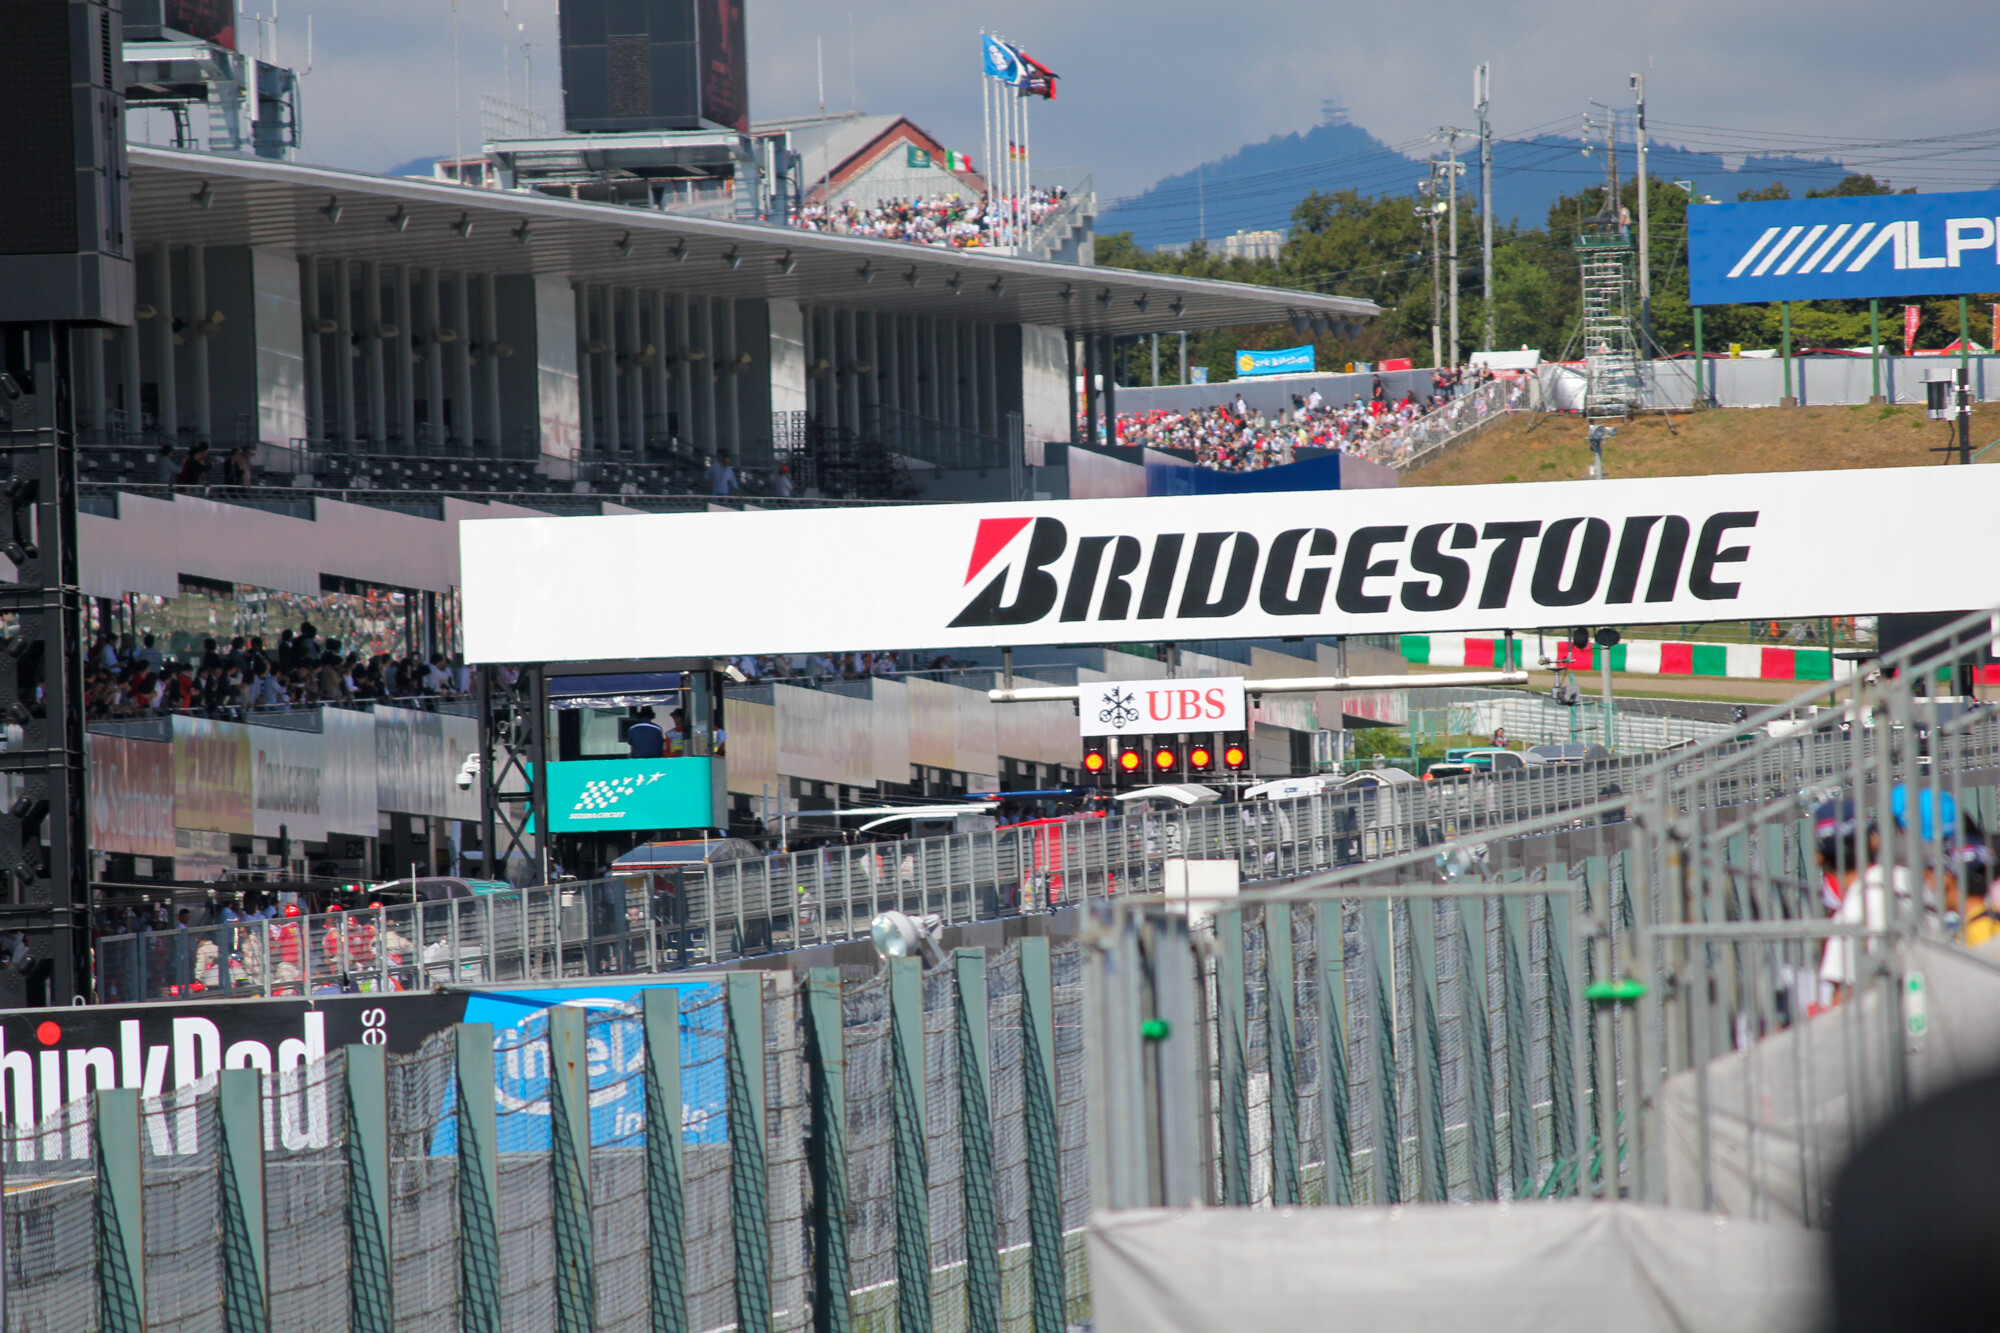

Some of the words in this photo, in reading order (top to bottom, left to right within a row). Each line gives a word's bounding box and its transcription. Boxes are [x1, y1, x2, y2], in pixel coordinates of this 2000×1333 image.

[1846, 217, 2000, 273] ALP
[946, 510, 1760, 628] BRIDGESTONE
[1146, 687, 1226, 722] UBS
[506, 1023, 625, 1080] inel
